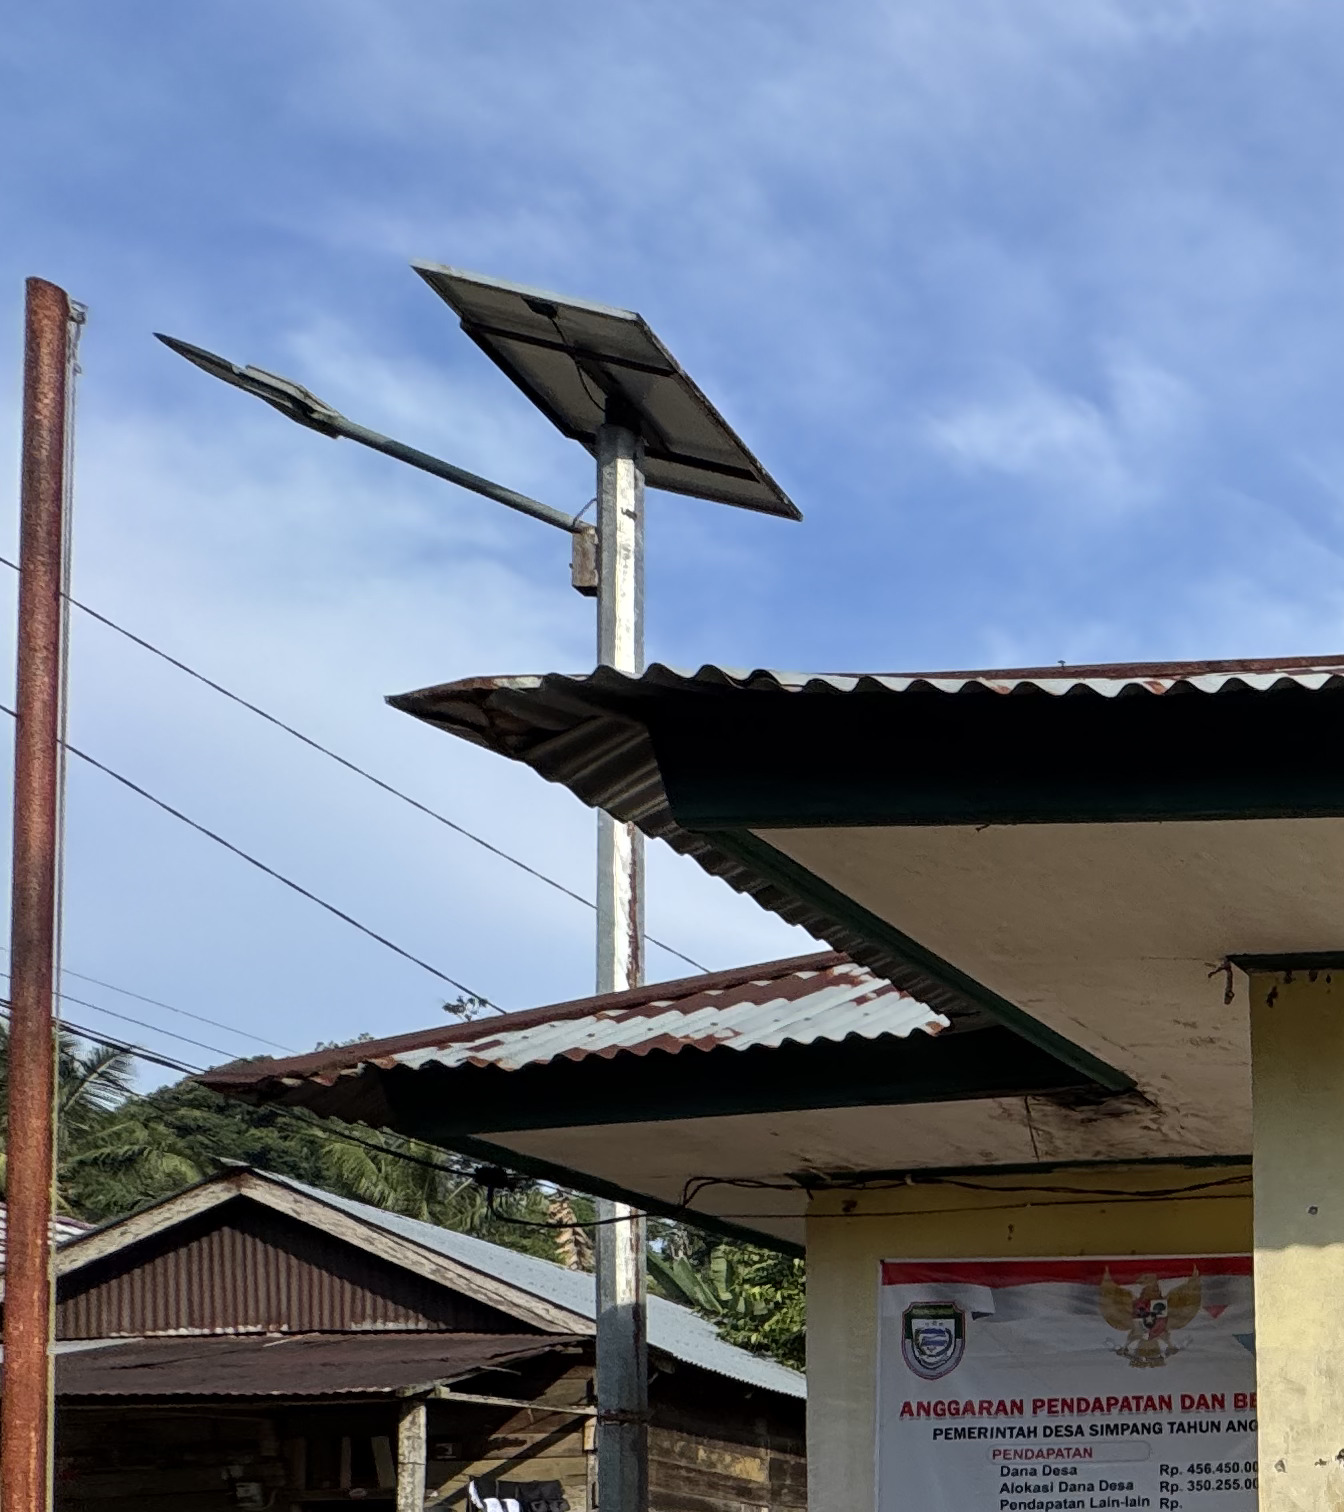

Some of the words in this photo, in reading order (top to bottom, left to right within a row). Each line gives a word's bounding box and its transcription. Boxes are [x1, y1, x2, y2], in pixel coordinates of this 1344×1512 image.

[899, 1399, 1024, 1418] ANGGARAN
[1032, 1394, 1173, 1415] PENDAPATAN
[1180, 1393, 1226, 1411] DAN
[933, 1426, 1037, 1440] PEMERINTAH
[1043, 1424, 1085, 1438] DESA
[1089, 1422, 1163, 1436] SIMPANG
[1167, 1420, 1221, 1434] TAHUN
[992, 1446, 1093, 1460] PENDAPATAN
[1000, 1465, 1037, 1477] Dana
[1042, 1464, 1078, 1476] Desa
[1159, 1463, 1183, 1477] Rp.
[999, 1482, 1054, 1494] Alokasi
[1058, 1481, 1095, 1493] Dana
[1099, 1479, 1134, 1492] Desa
[1159, 1481, 1183, 1494] Rp.
[1000, 1498, 1085, 1512] Pendapatan
[1090, 1495, 1150, 1509] Lain-lain
[1159, 1497, 1183, 1511] Rp.
